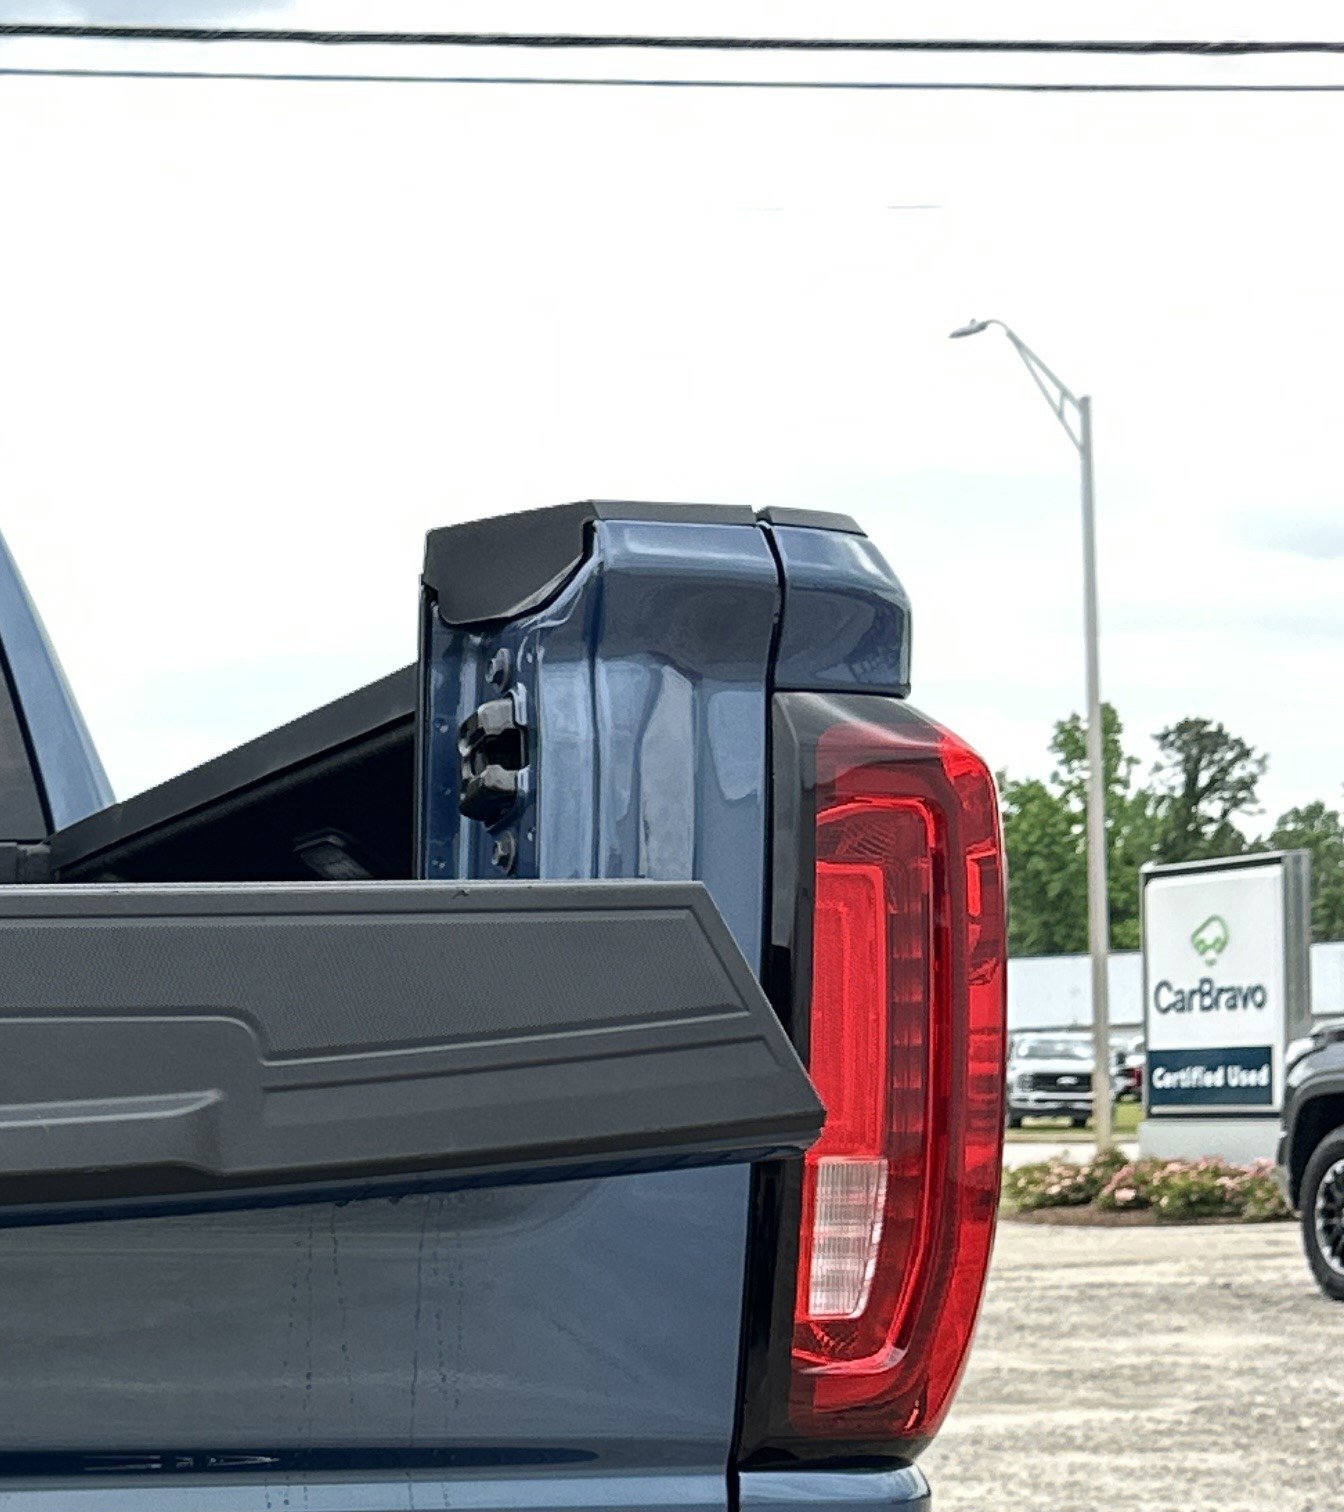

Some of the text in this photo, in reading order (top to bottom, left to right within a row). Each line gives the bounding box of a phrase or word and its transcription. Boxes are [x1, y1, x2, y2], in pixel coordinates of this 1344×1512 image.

[1154, 977, 1268, 1015] CarBravo
[1153, 1063, 1270, 1089] Certified Used
